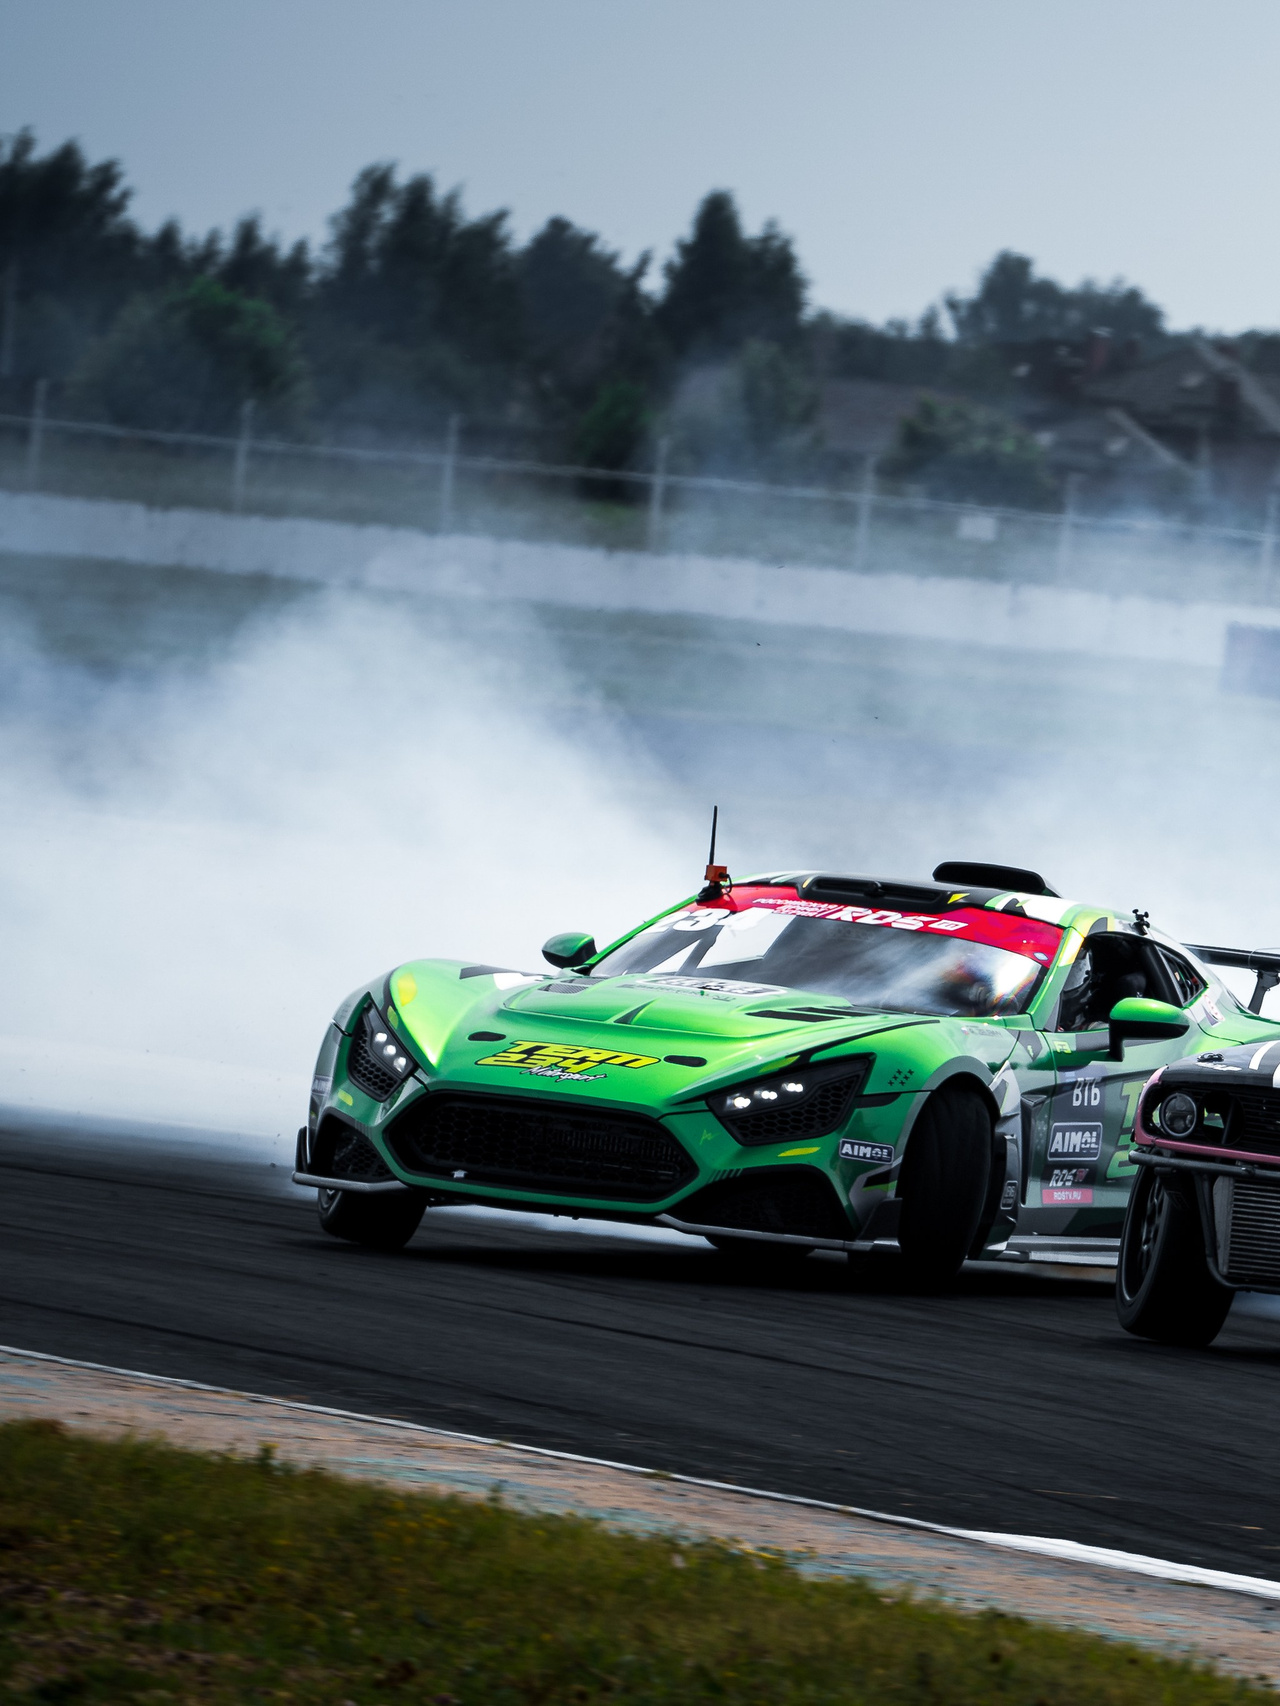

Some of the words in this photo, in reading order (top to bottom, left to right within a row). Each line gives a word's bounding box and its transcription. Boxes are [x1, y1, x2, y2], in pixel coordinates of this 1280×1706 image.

[826, 906, 939, 930] RDS
[475, 1054, 602, 1073] 234
[510, 1040, 661, 1069] TEAM
[1072, 1077, 1100, 1107] ВТБ
[841, 1143, 891, 1159] AIMOL
[1050, 1131, 1098, 1153] AIMOL
